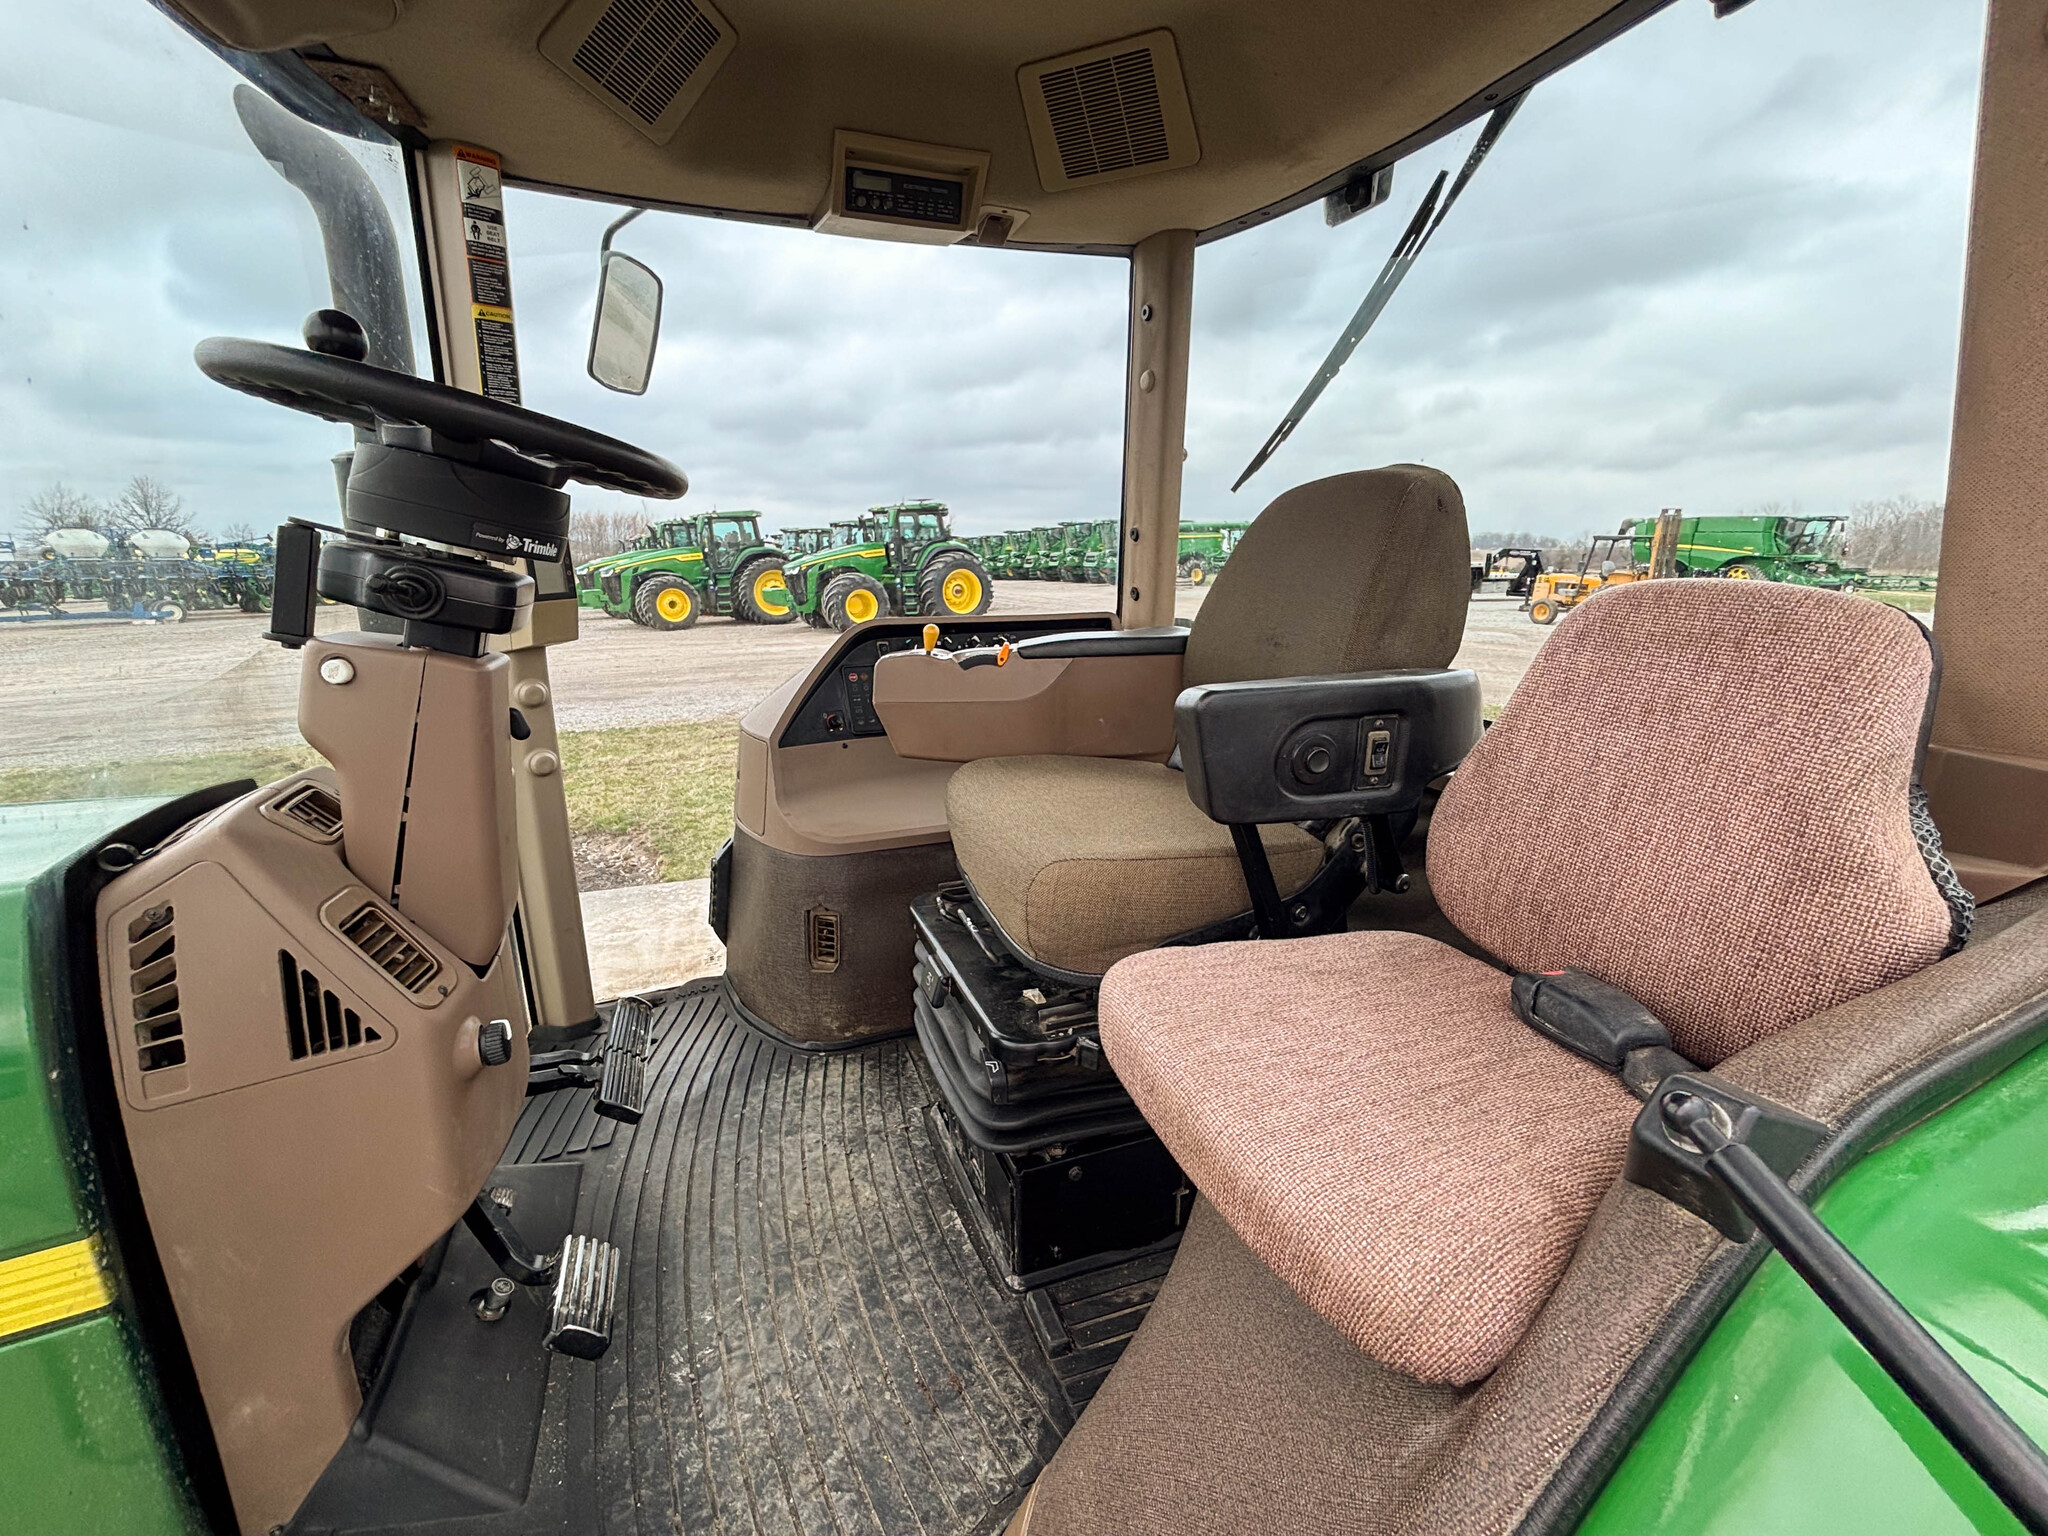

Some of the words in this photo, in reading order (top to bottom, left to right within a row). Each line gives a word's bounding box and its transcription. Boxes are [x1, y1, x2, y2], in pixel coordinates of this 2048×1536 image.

[475, 532, 498, 542] Powered
[498, 536, 505, 544] by
[523, 537, 558, 557] Trimble
